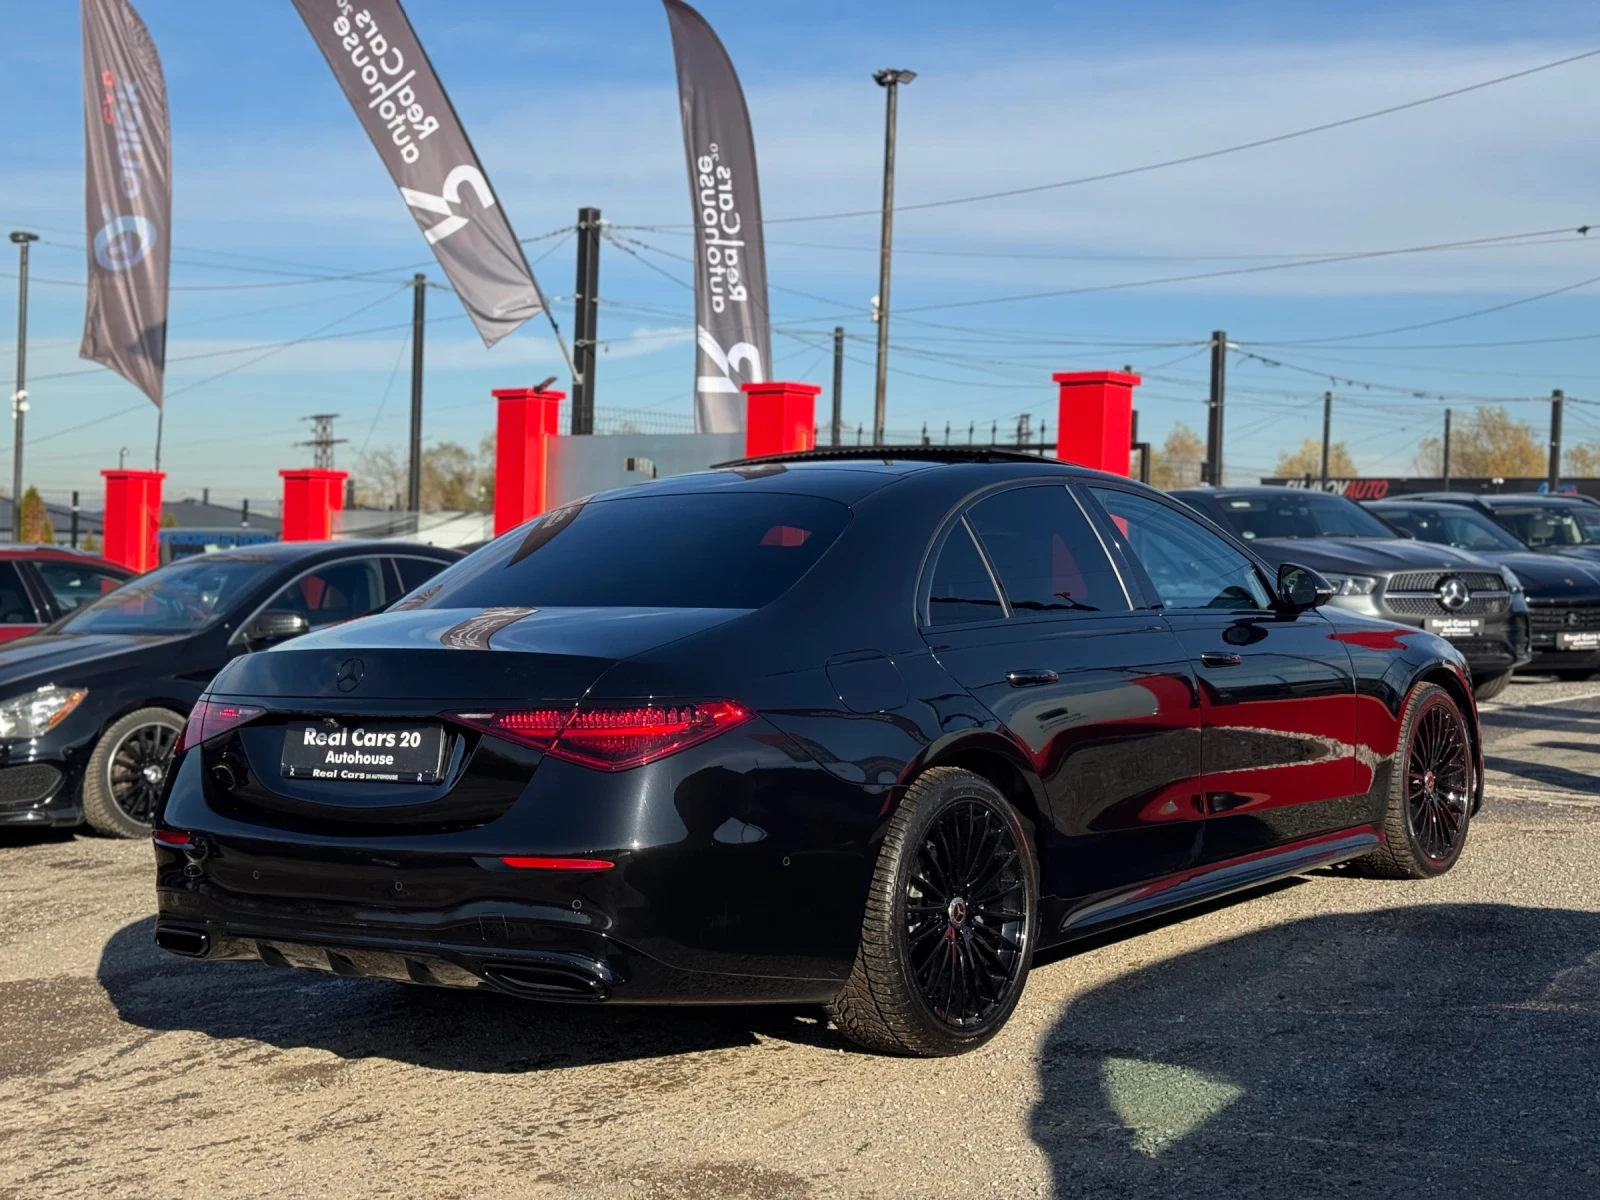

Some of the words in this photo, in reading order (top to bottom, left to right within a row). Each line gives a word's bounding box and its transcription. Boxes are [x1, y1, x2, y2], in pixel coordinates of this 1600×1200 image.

[303, 727, 348, 746] Real
[352, 728, 396, 747] Cars
[399, 732, 421, 748] 20
[325, 750, 394, 765] Autohouse
[312, 768, 338, 778] Real
[341, 769, 365, 779] Cars
